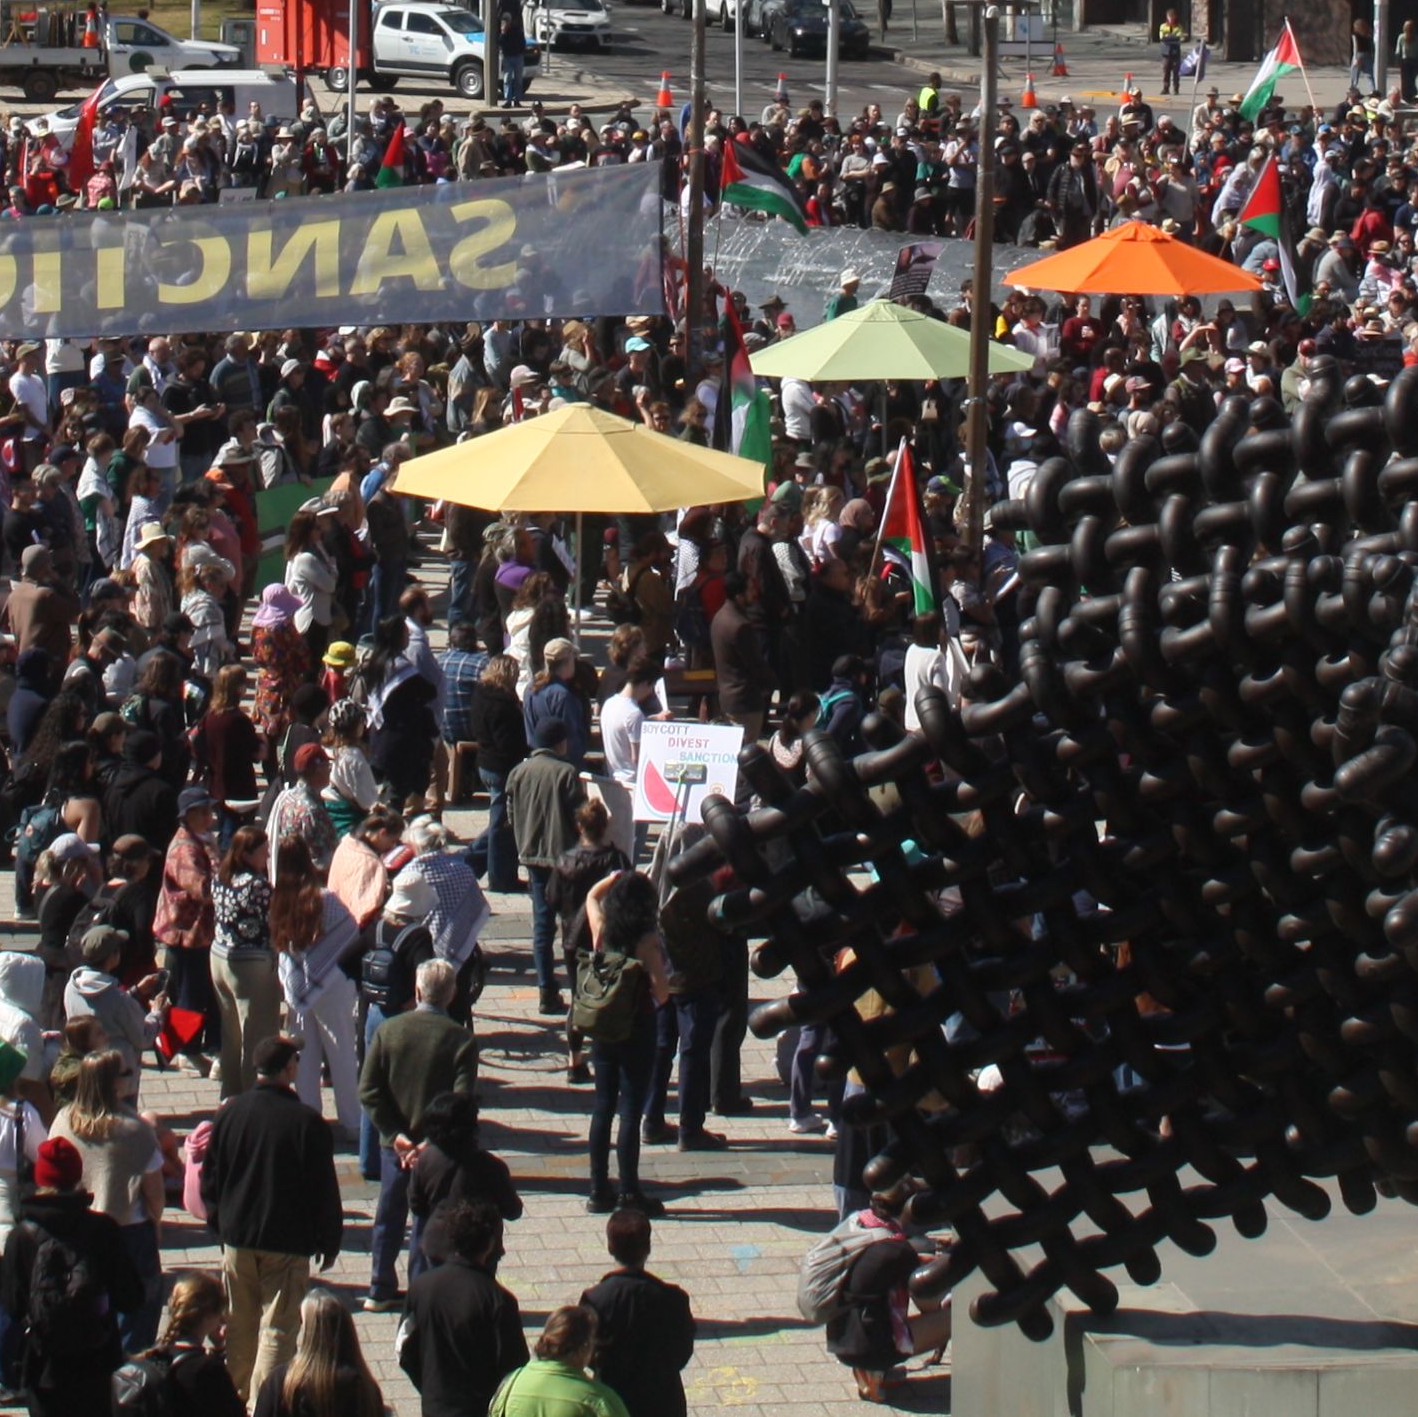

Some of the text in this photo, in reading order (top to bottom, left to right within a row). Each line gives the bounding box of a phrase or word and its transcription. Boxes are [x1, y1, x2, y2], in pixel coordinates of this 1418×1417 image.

[642, 724, 690, 735] BOYCOTT
[668, 737, 710, 749] DIVEST
[679, 751, 738, 764] SANCTION
